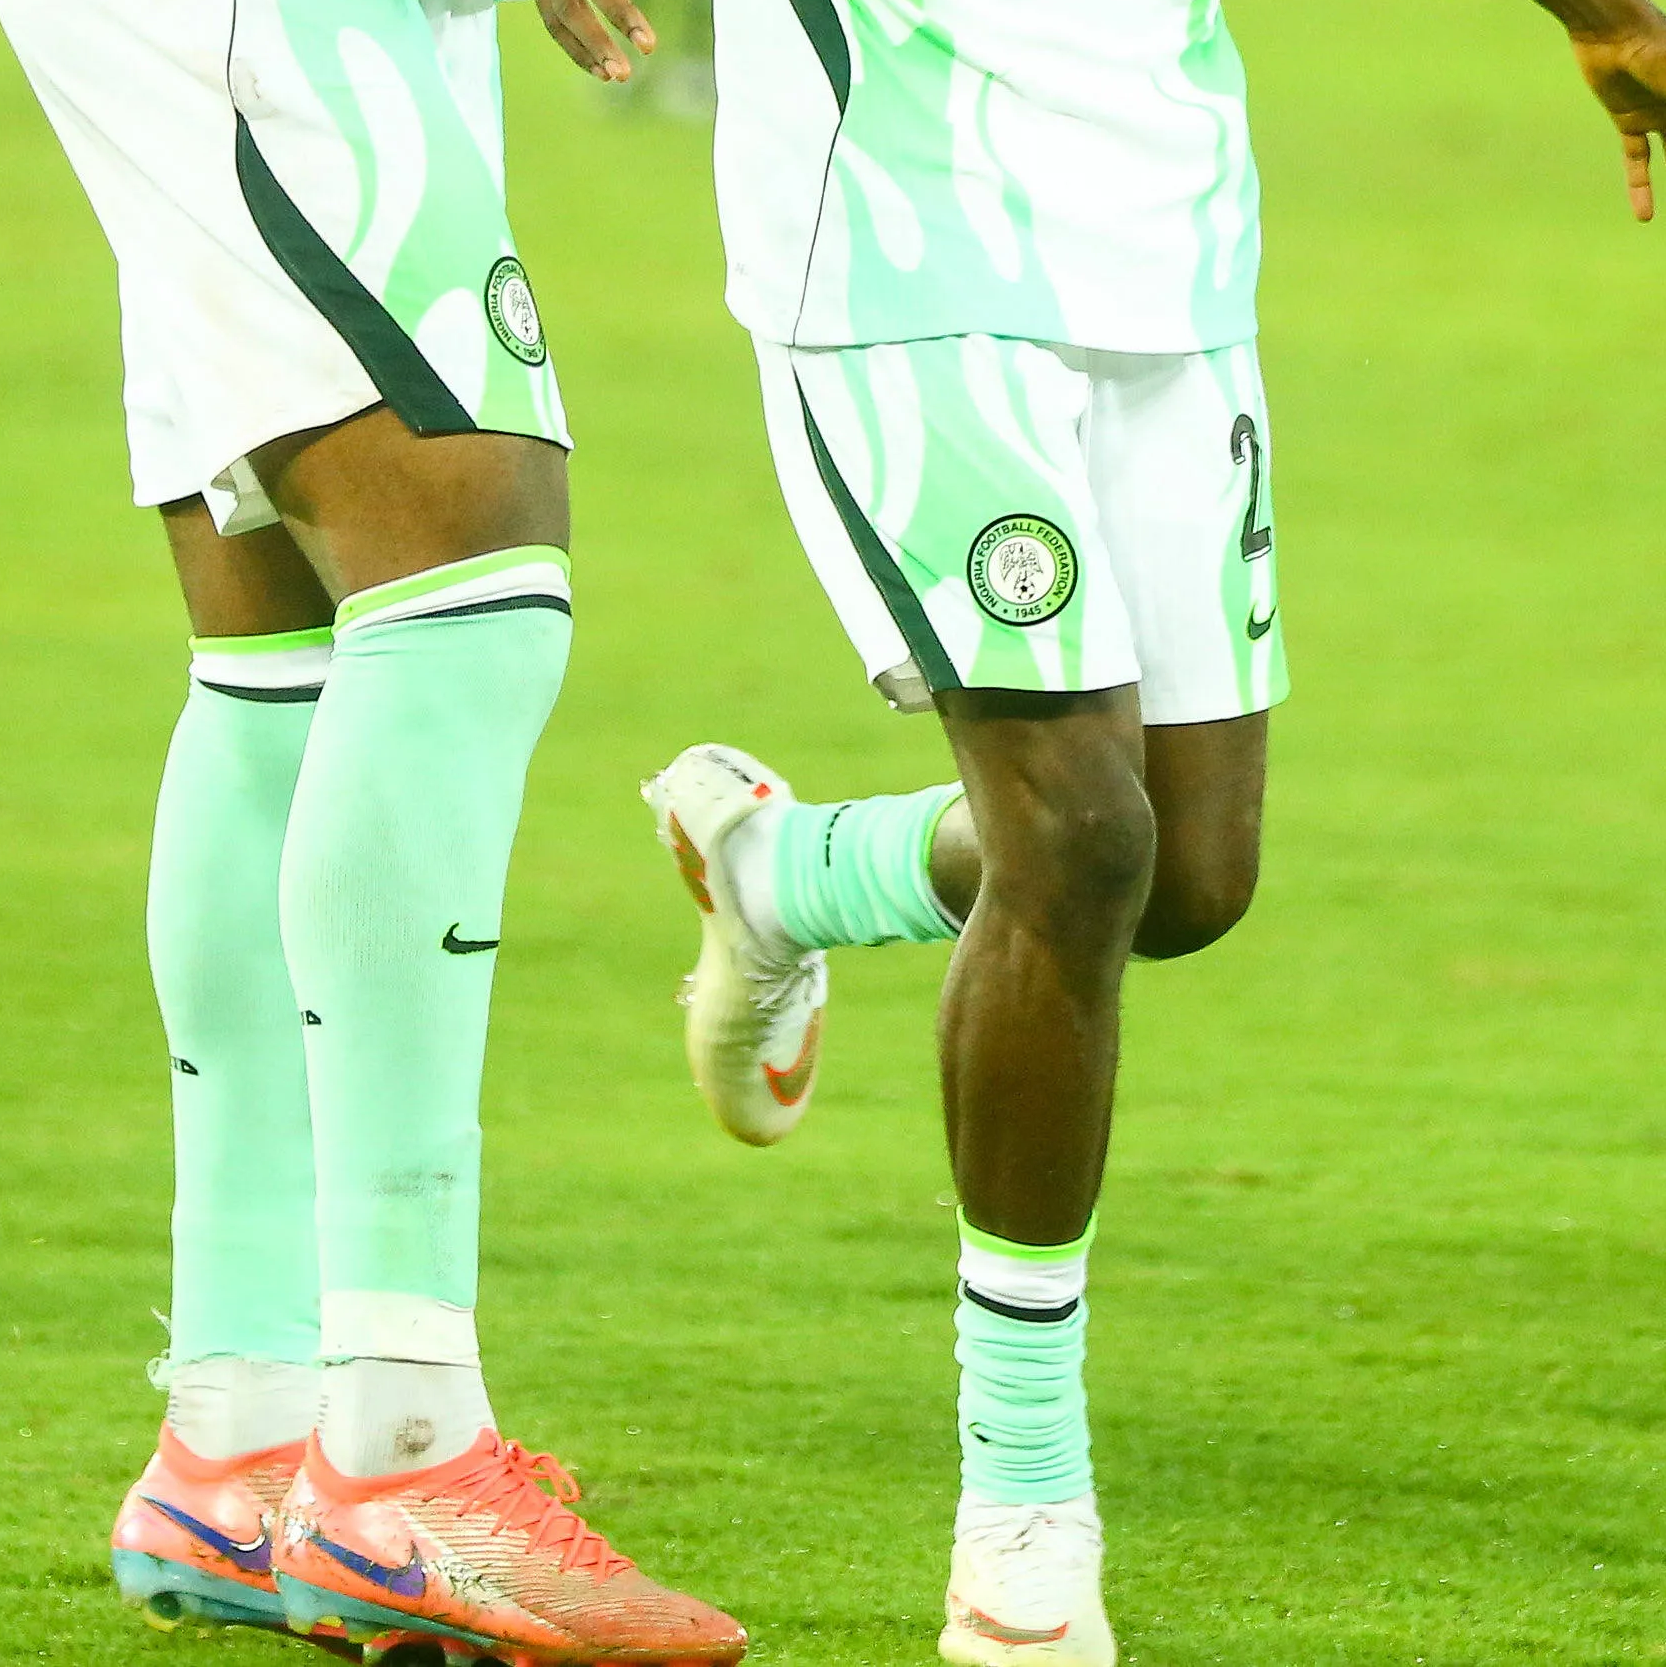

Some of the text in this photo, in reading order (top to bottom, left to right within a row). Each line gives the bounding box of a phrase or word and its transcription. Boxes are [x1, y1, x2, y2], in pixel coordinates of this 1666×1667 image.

[973, 521, 1071, 608] NIGERIA FOOTBALL FEDERATION
[1015, 604, 1042, 619] 1945
